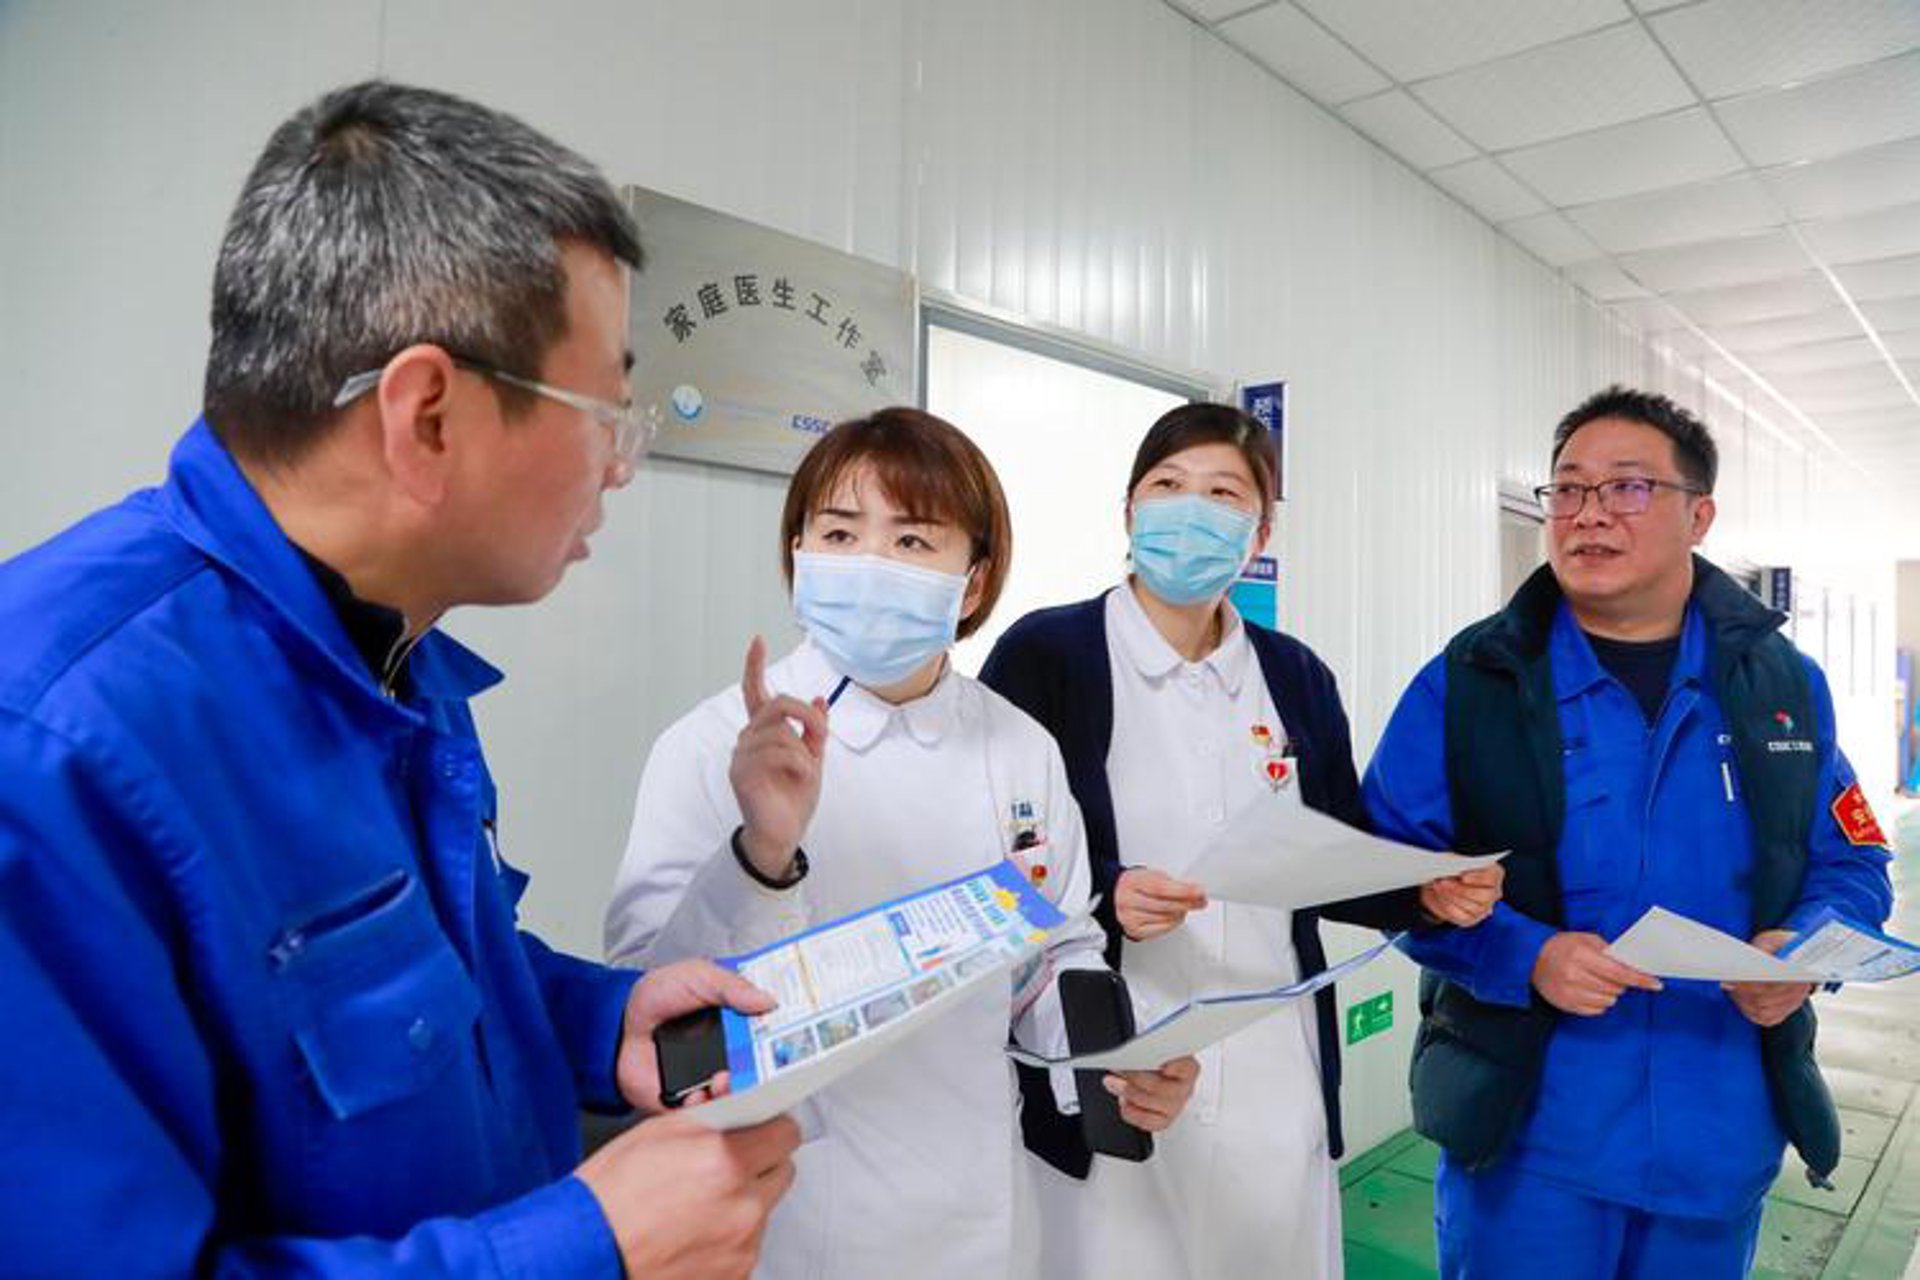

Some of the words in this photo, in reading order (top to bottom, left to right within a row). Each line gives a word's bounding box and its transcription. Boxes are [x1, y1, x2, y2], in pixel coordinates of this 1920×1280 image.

[663, 274, 887, 388] 家庭医生工作室
